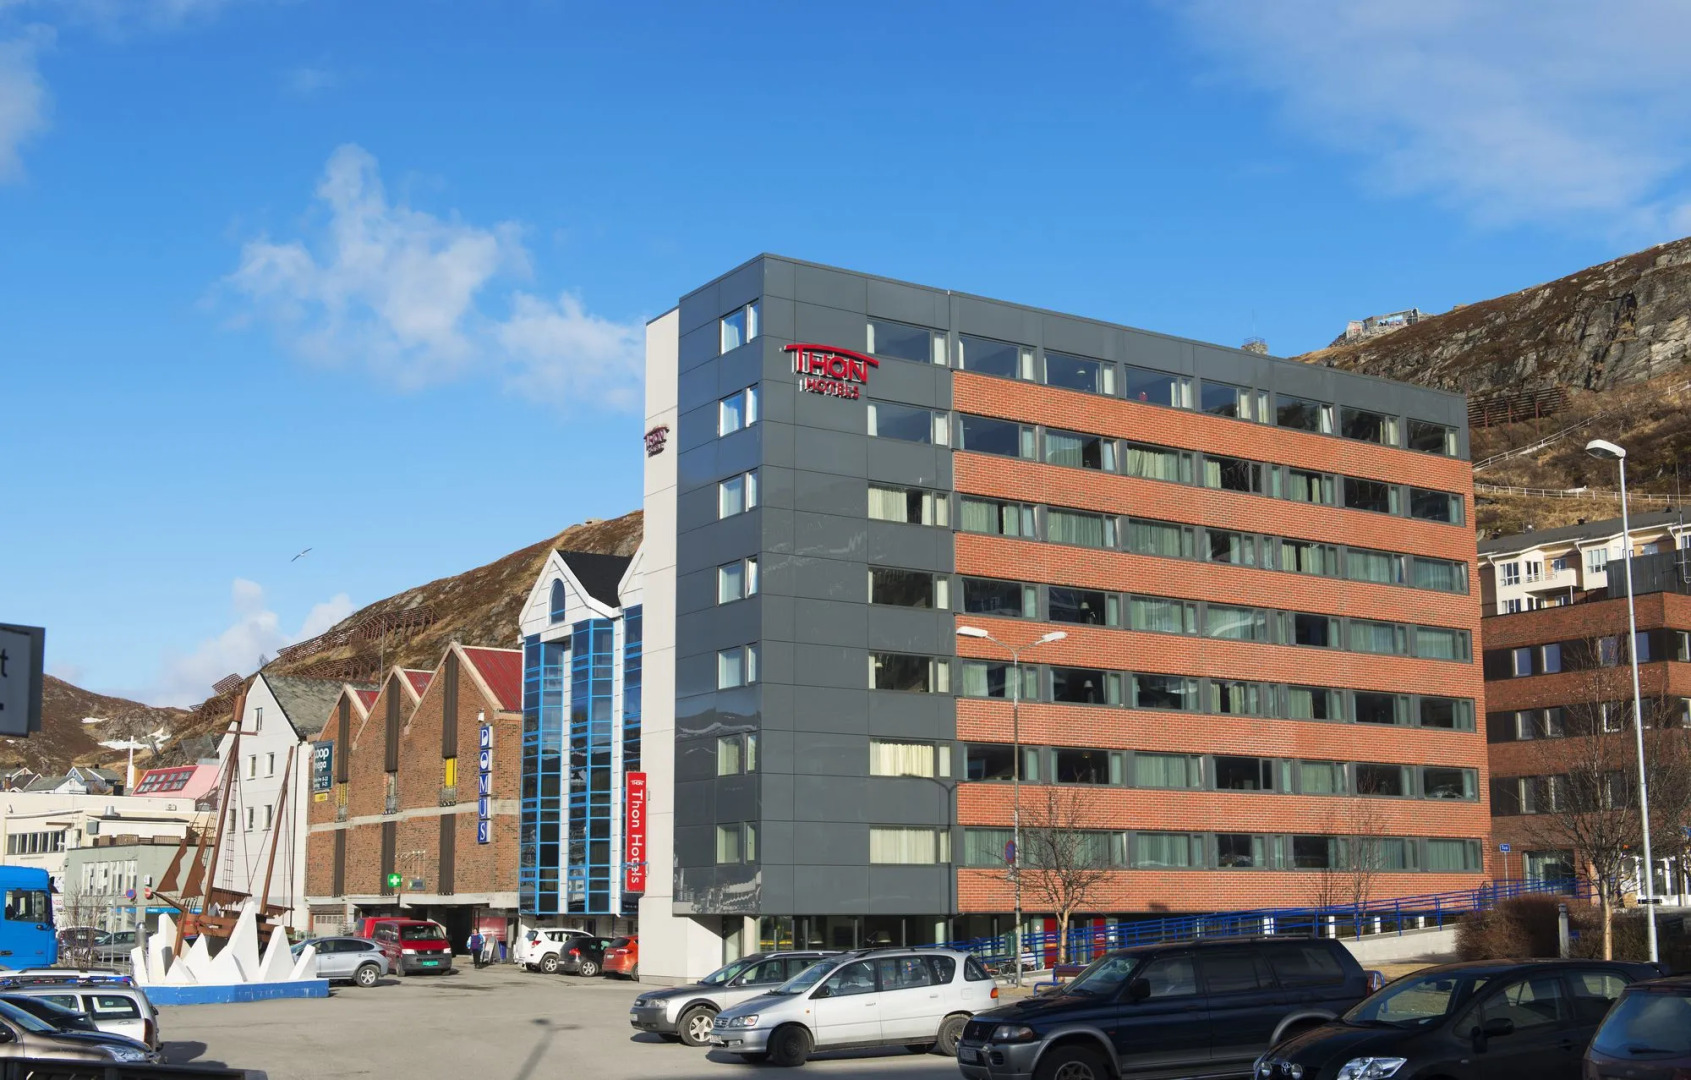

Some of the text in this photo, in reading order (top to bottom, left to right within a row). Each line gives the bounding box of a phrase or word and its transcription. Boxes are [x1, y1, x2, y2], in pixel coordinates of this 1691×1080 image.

[784, 343, 879, 384] THON
[804, 377, 860, 399] HOTELS
[479, 728, 489, 841] DOMUS
[631, 789, 644, 884] Thon Hotels
